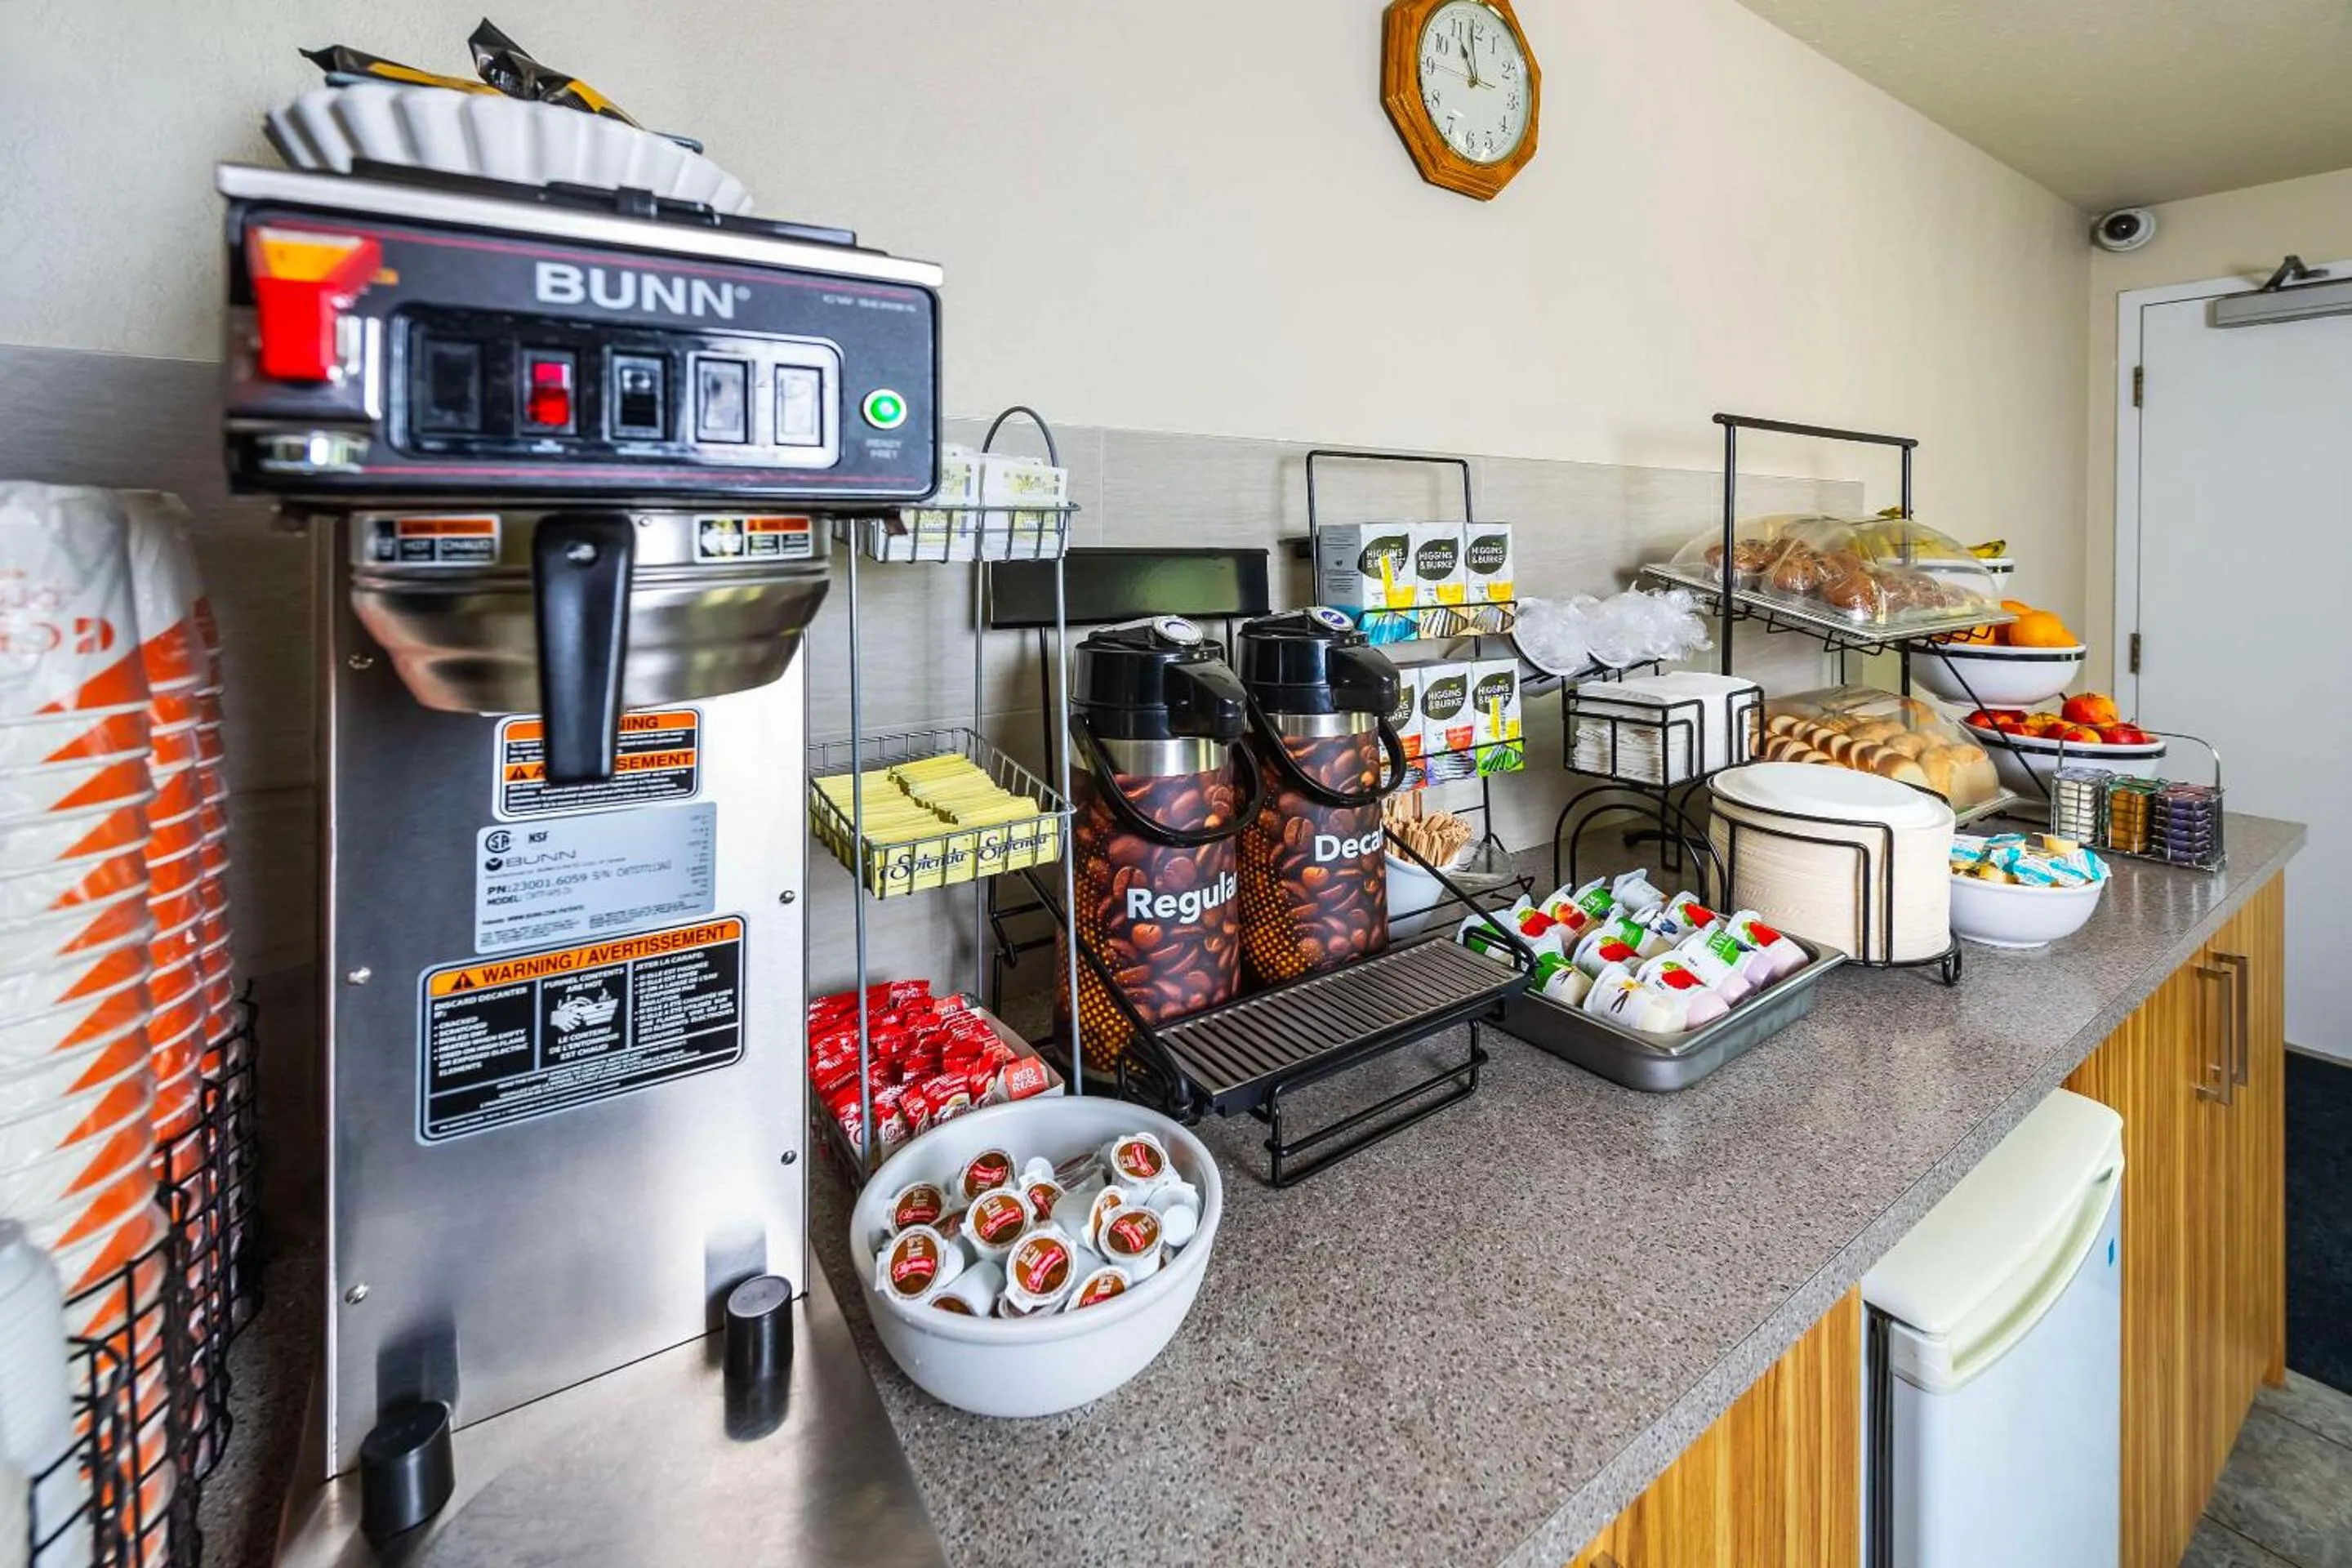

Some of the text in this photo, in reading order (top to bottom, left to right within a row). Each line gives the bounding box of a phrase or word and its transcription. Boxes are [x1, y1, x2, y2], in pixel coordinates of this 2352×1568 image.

[1436, 33, 1449, 56] 10
[1426, 56, 1435, 75] 9
[1501, 61, 1511, 79] 2
[1431, 89, 1441, 108] 8
[1507, 92, 1516, 110] 3
[1498, 115, 1508, 132] 4
[1465, 131, 1475, 149] 6
[1485, 131, 1494, 149] 5
[536, 261, 734, 319] BUNN
[1419, 551, 1453, 561] HIGGINS
[1472, 546, 1503, 555] HIGGINS
[1428, 688, 1463, 700] HIGGINS
[528, 831, 550, 844] NSF
[1315, 819, 1383, 862] Deca
[506, 849, 576, 867] BUNN
[1127, 871, 1238, 924] Regula
[483, 954, 572, 983] WARNING
[588, 924, 728, 965] AVERTISSEMENT
[1013, 1067, 1035, 1080] RED
[1013, 1077, 1042, 1091] ROSE
